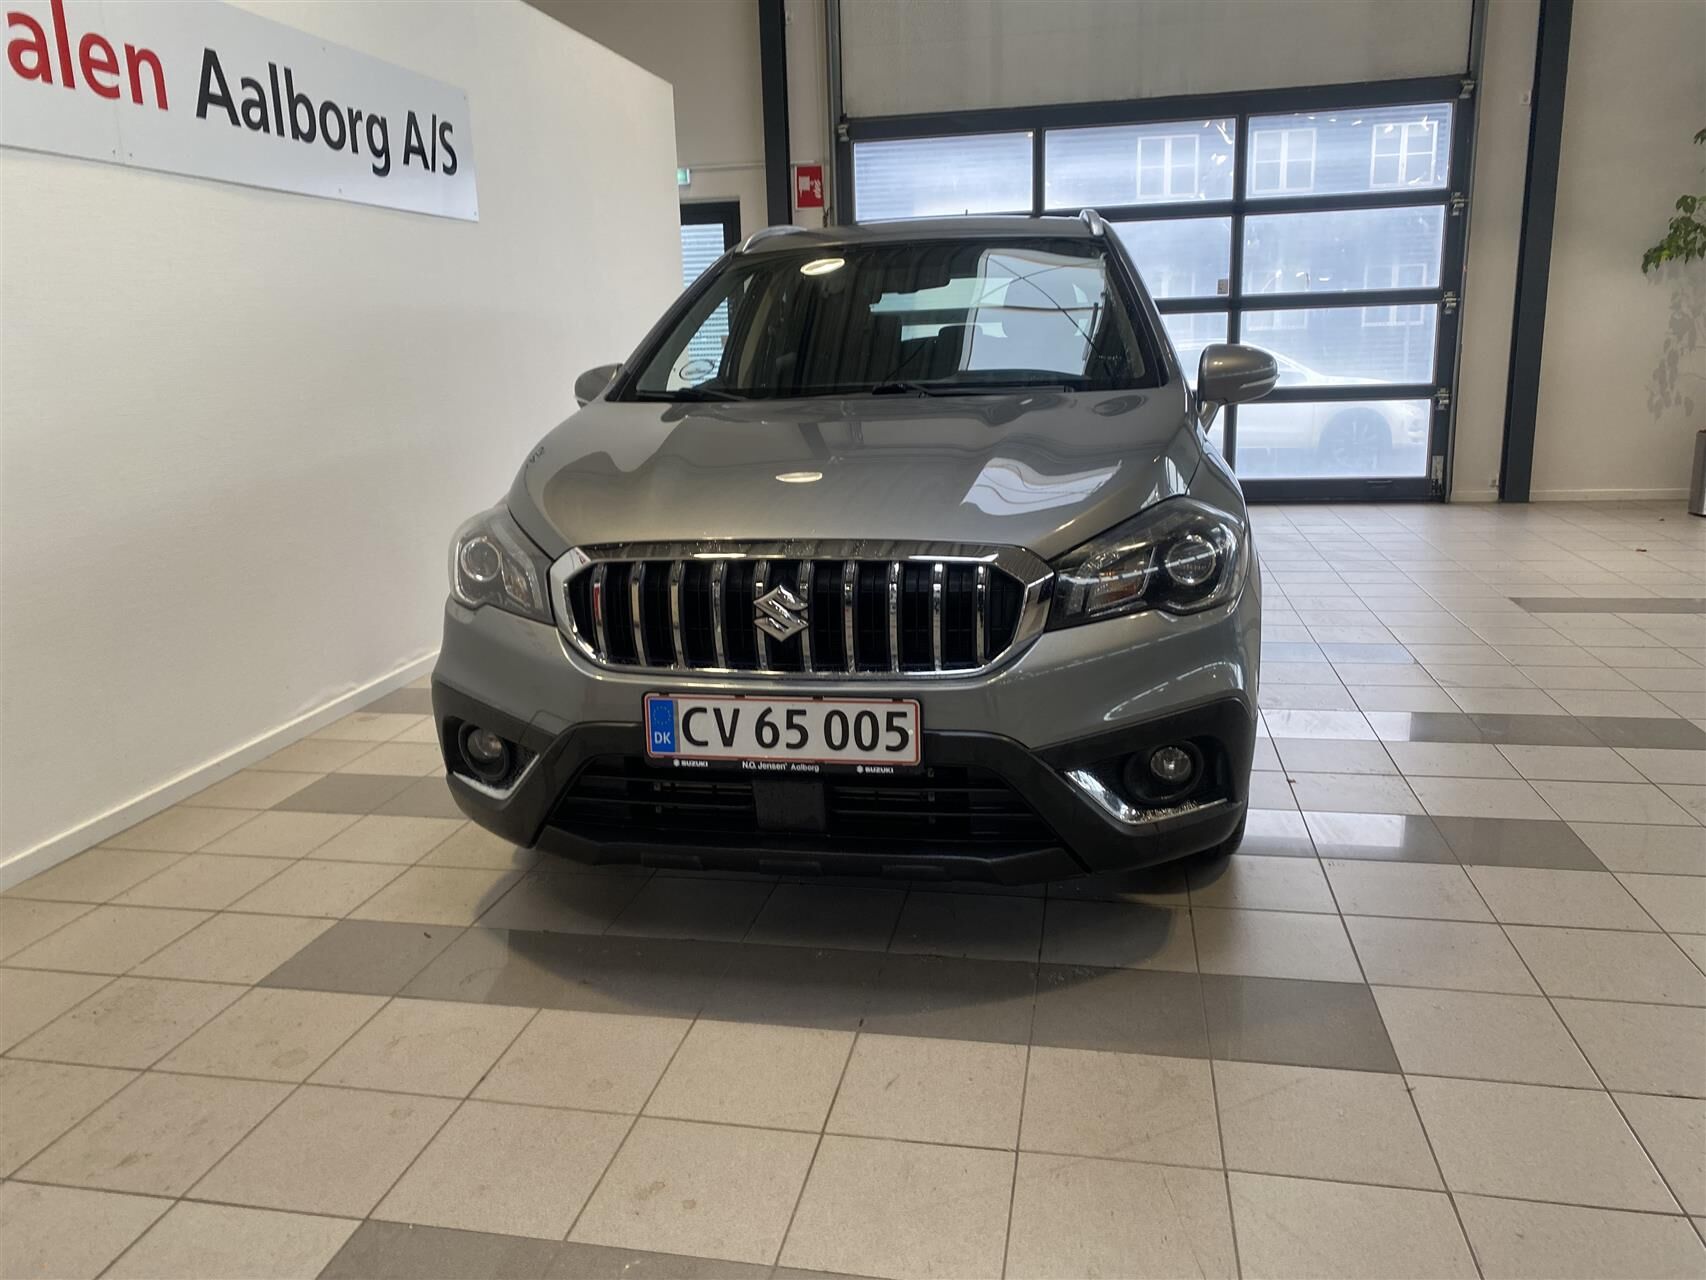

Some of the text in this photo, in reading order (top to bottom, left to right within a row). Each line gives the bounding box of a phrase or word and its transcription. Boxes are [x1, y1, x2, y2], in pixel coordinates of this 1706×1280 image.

[6, 0, 459, 177] alen Aalborg A/S
[681, 706, 911, 752] CV 65 005
[654, 731, 671, 745] DK
[790, 763, 820, 773] Aalborg
[865, 766, 894, 774] SUZUKI
